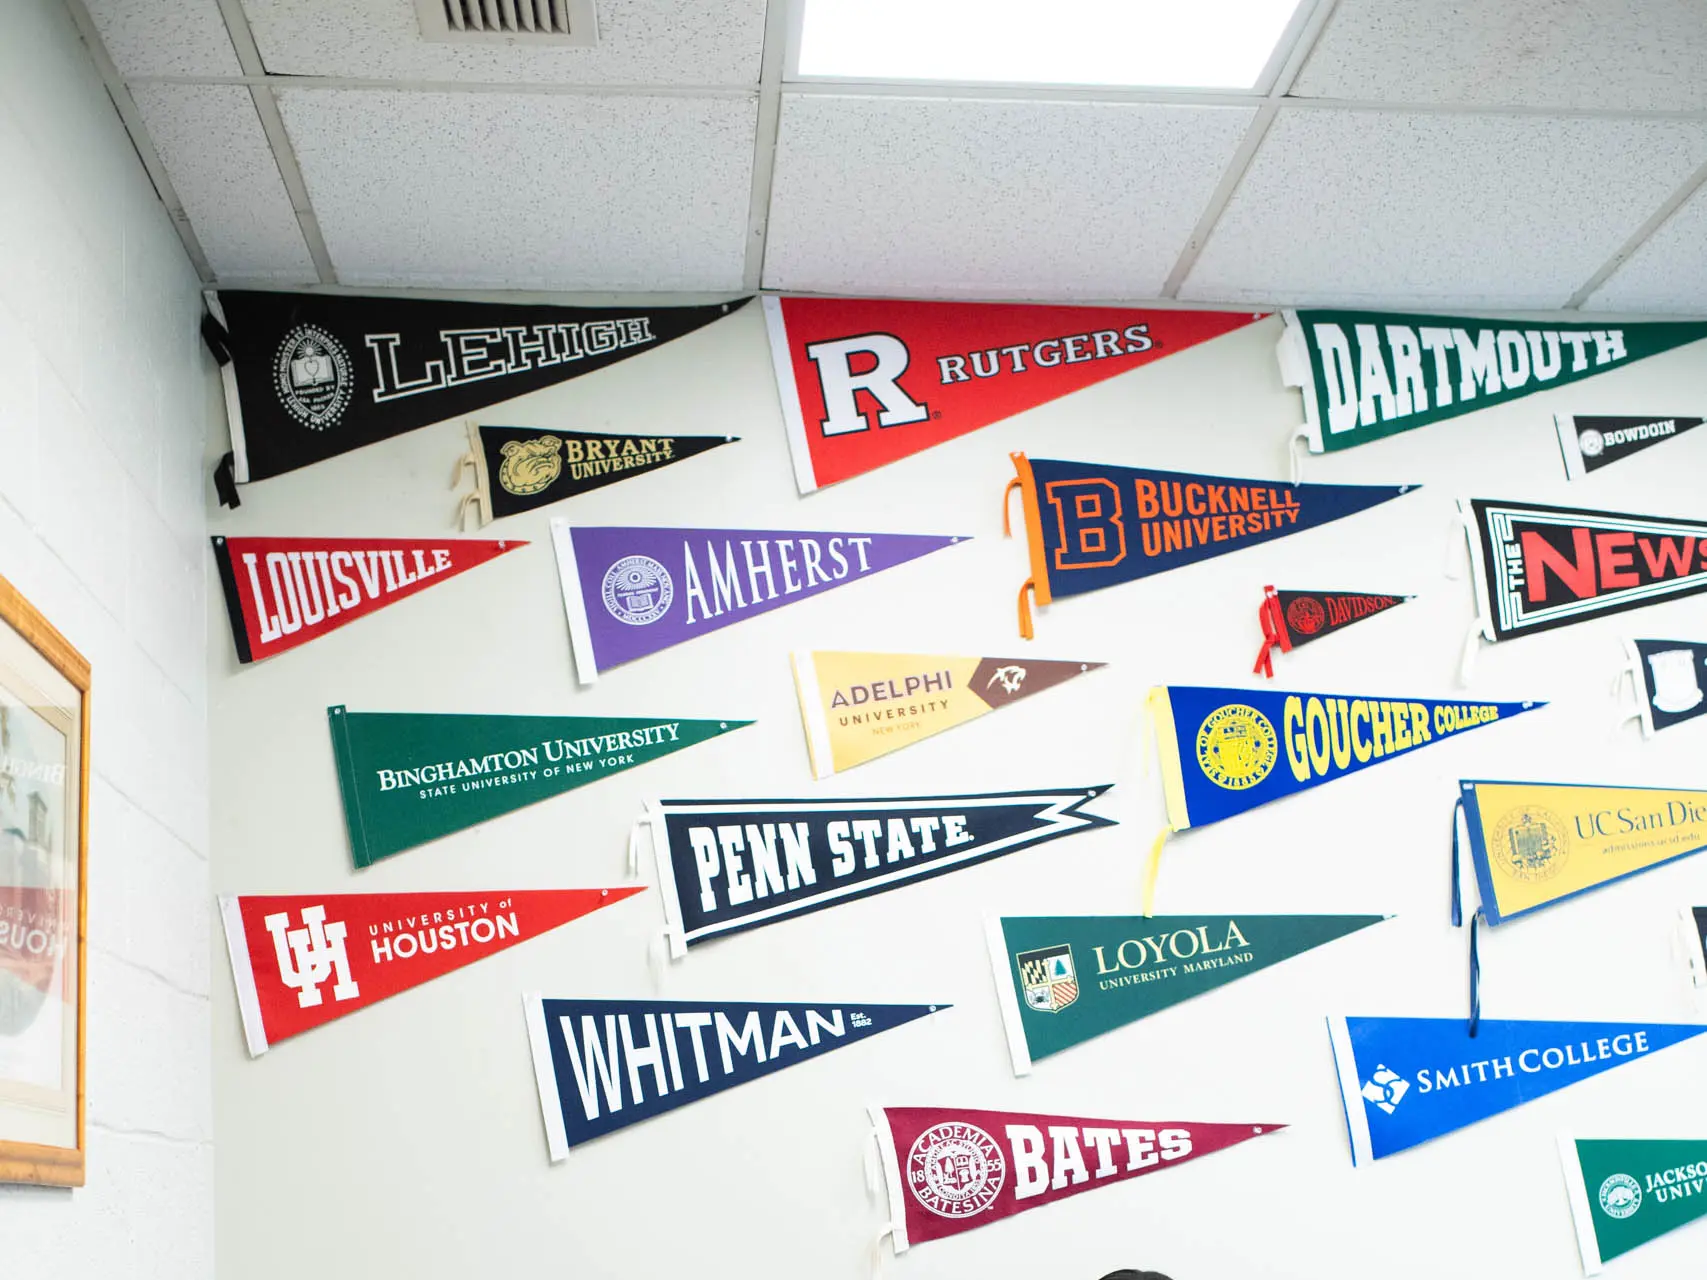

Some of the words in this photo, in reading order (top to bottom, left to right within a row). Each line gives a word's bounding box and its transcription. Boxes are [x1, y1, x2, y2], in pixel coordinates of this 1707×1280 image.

[365, 317, 652, 403] LEHIGH
[936, 324, 1156, 385] RUTGERS
[1312, 322, 1628, 435] DARTMOUTH
[805, 331, 929, 437] R
[566, 438, 675, 465] BRYANT
[1603, 419, 1676, 447] BOWDOIN
[571, 450, 675, 481] UNIVERSITY
[1045, 477, 1126, 570] B
[1135, 479, 1301, 520] BUCKNELL
[1141, 508, 1301, 558] UNIVERSITY
[684, 536, 874, 625] AMHERST
[1504, 543, 1526, 592] THE
[1520, 527, 1707, 603] NEW
[242, 548, 452, 644] LOUISVILLE
[1324, 596, 1393, 627] DAVIDSON
[831, 670, 952, 709] ADELPHI
[839, 699, 949, 727] UNIVERSITY
[377, 747, 539, 793] BINGHAMTON
[541, 722, 681, 765] UNIVERSITY
[1283, 695, 1432, 783] GOUCHER
[1434, 703, 1499, 734] COLLEGE
[419, 783, 457, 800] STATE
[461, 769, 537, 793] UNIVERSITY
[543, 765, 561, 779] OF
[565, 760, 596, 777] NEW
[599, 752, 635, 769] YORK
[1574, 809, 1612, 840] UC
[1616, 806, 1664, 835] San
[688, 822, 817, 913] PENN
[829, 814, 970, 878] STATE
[368, 902, 488, 936] UNIVERSITY
[498, 897, 513, 909] of
[371, 912, 520, 965] HOUSTON
[1093, 919, 1252, 976] LOYOLA
[1099, 967, 1178, 992] UNIVERSITY
[1183, 951, 1254, 976] MARYLAND
[851, 1018, 873, 1029] 1882
[559, 1008, 847, 1122] WHITMAN
[1416, 1057, 1516, 1095] SMITH
[1518, 1031, 1650, 1074] COLLEGE
[913, 1125, 994, 1166] ACADEMIA
[986, 1158, 1002, 1172] 55
[1004, 1122, 1193, 1201] BATES
[911, 1169, 926, 1184] 18
[918, 1176, 1001, 1214] BATESINA
